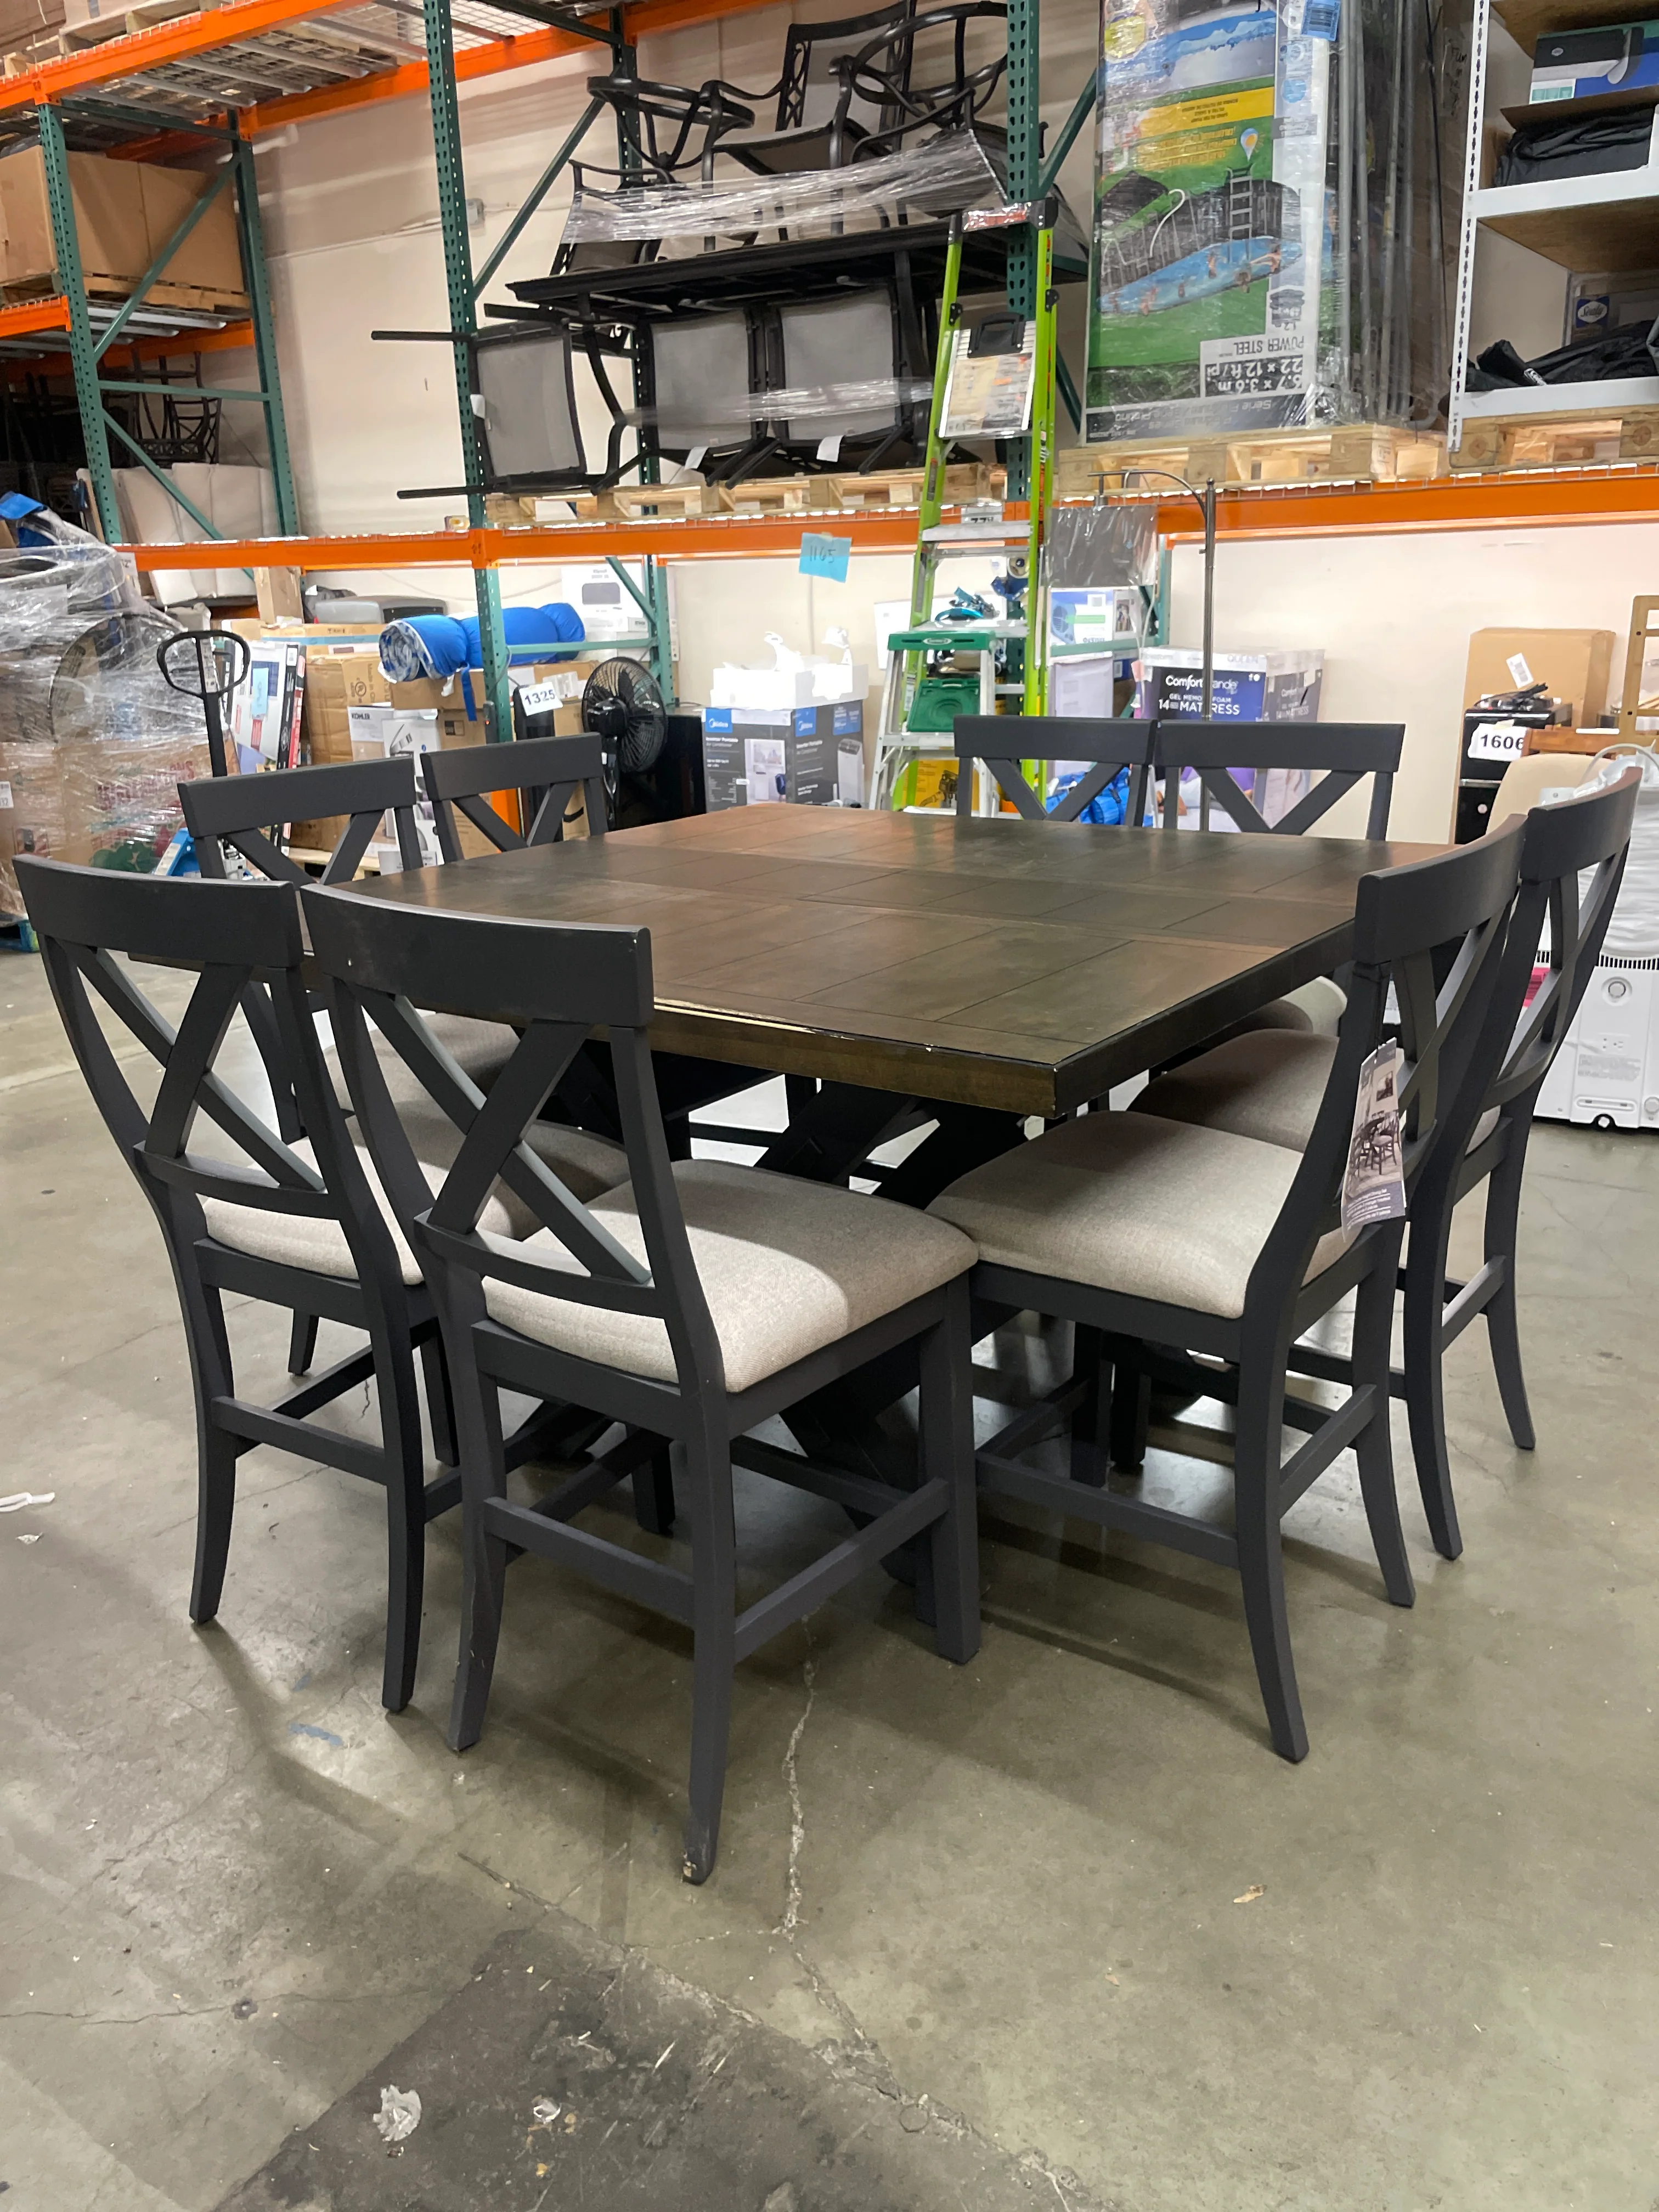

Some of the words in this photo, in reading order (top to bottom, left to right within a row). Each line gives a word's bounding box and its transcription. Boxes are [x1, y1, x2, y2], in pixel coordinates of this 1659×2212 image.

[1234, 341, 1263, 356] STEEL
[1267, 336, 1305, 352] POWER
[1206, 363, 1220, 381] pi
[1231, 364, 1242, 379] ft
[1244, 362, 1263, 377] 12
[1280, 358, 1302, 374] 22
[1218, 381, 1232, 391] m
[1235, 379, 1259, 393] 3.6
[809, 545, 837, 564] 1165
[524, 689, 555, 706] 1325
[1159, 698, 1170, 710] 14
[1180, 701, 1240, 715] MATRESS
[1481, 734, 1524, 749] 1606
